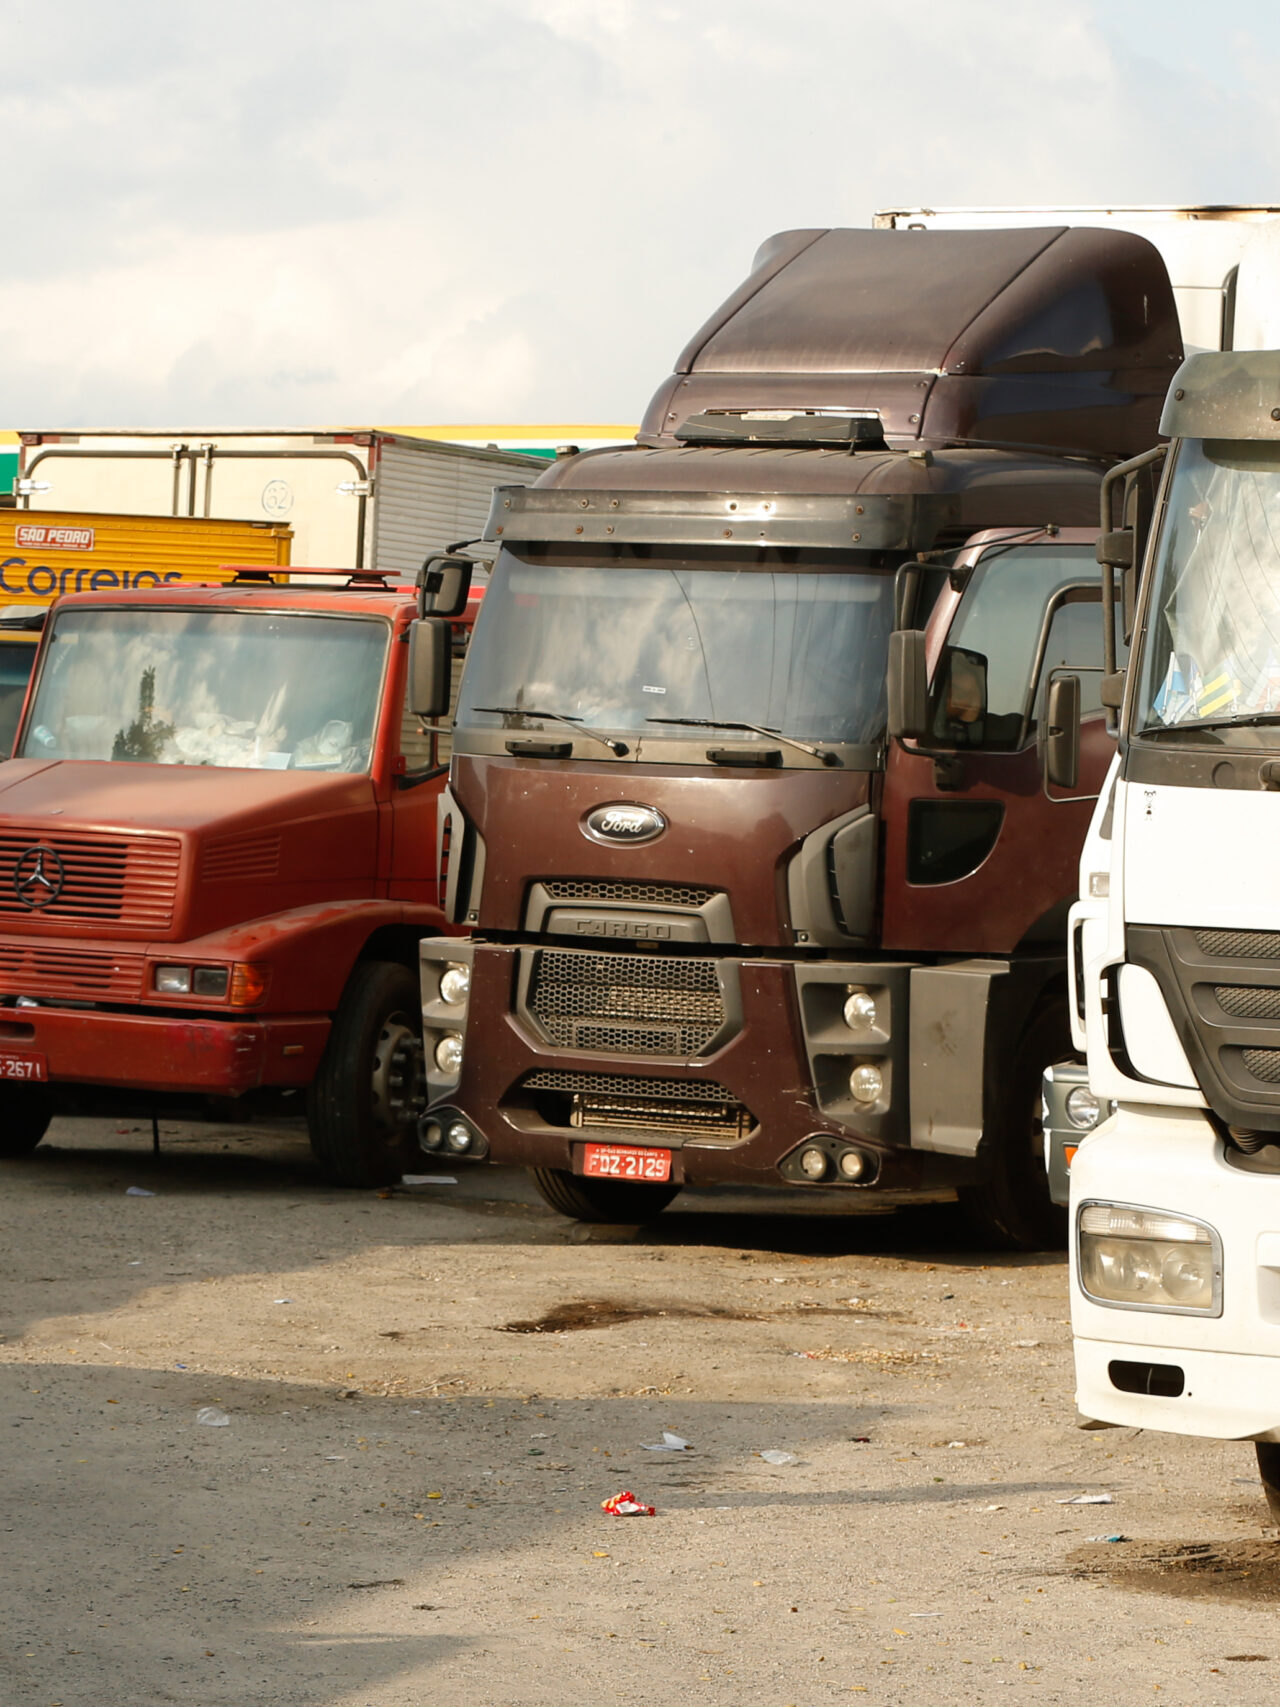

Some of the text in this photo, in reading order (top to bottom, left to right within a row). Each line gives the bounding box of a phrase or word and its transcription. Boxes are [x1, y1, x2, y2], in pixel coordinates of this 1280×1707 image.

[47, 530, 90, 544] PEDRO
[601, 810, 646, 833] Ford
[576, 919, 671, 939] CARGO
